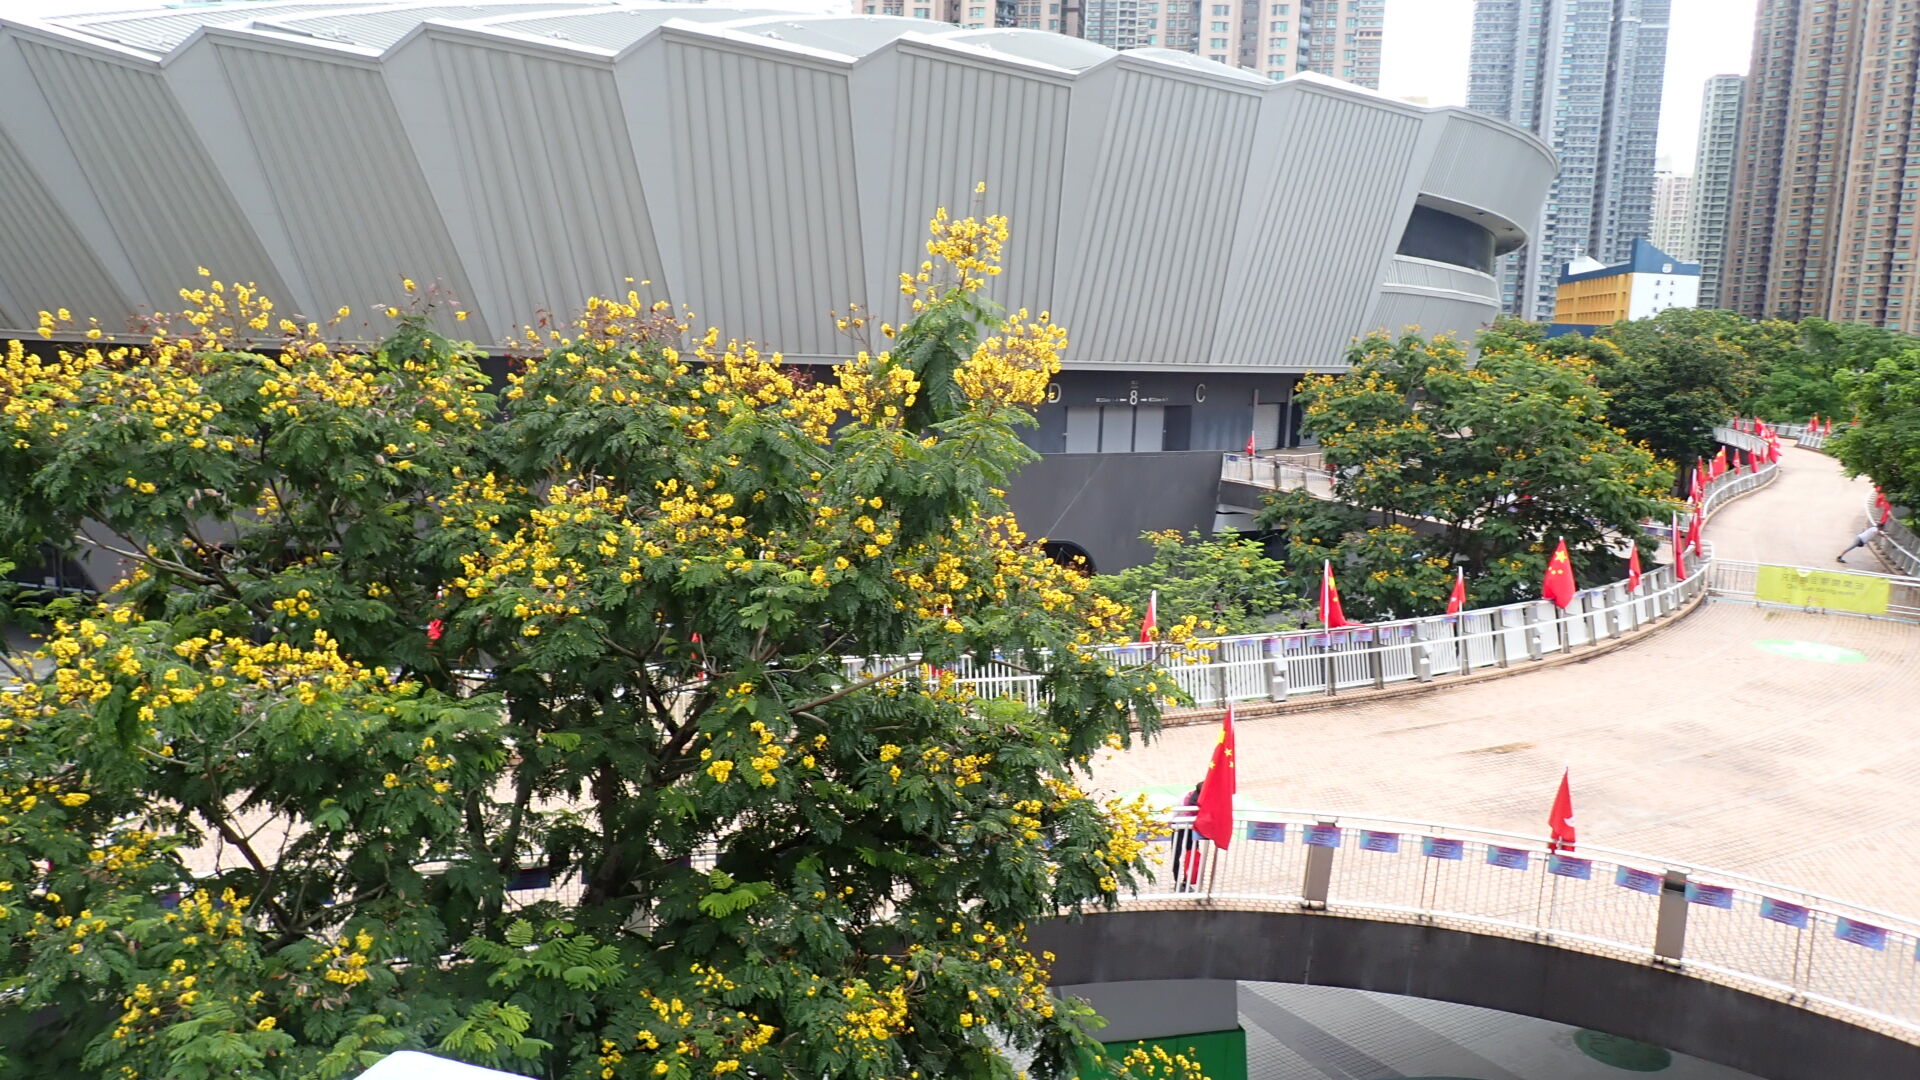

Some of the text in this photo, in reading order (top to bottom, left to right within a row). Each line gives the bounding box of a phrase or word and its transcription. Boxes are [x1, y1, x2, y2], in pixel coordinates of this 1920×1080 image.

[1048, 383, 1061, 403] D
[1129, 390, 1138, 405] 8
[1195, 383, 1206, 403] C
